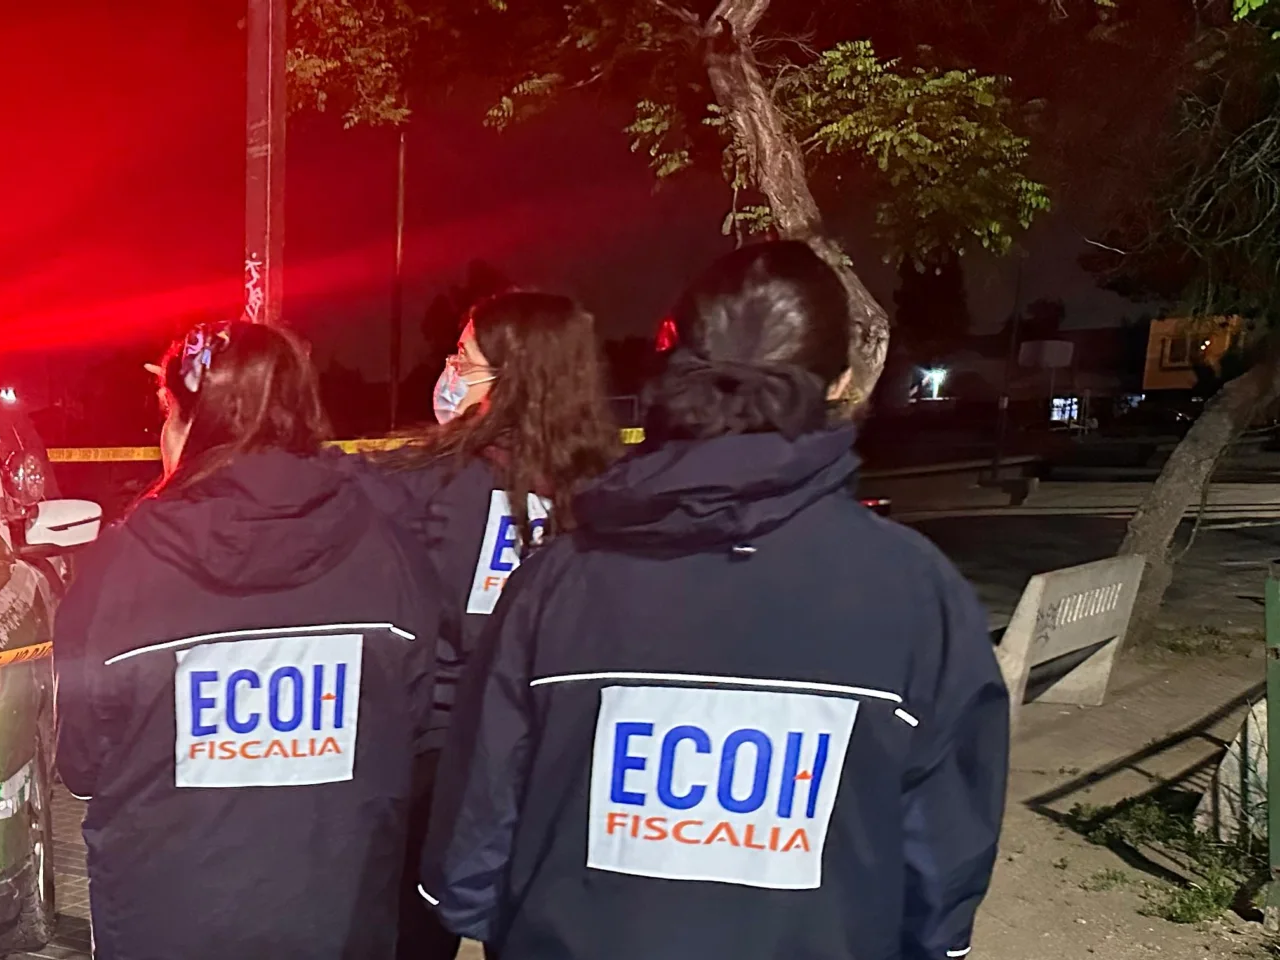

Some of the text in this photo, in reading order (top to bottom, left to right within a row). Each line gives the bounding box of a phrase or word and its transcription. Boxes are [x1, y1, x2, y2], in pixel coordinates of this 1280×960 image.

[189, 662, 348, 737] ECOH
[188, 737, 343, 760] FISCALIA
[610, 721, 832, 819] ECOH
[606, 812, 811, 853] FISCALIA
